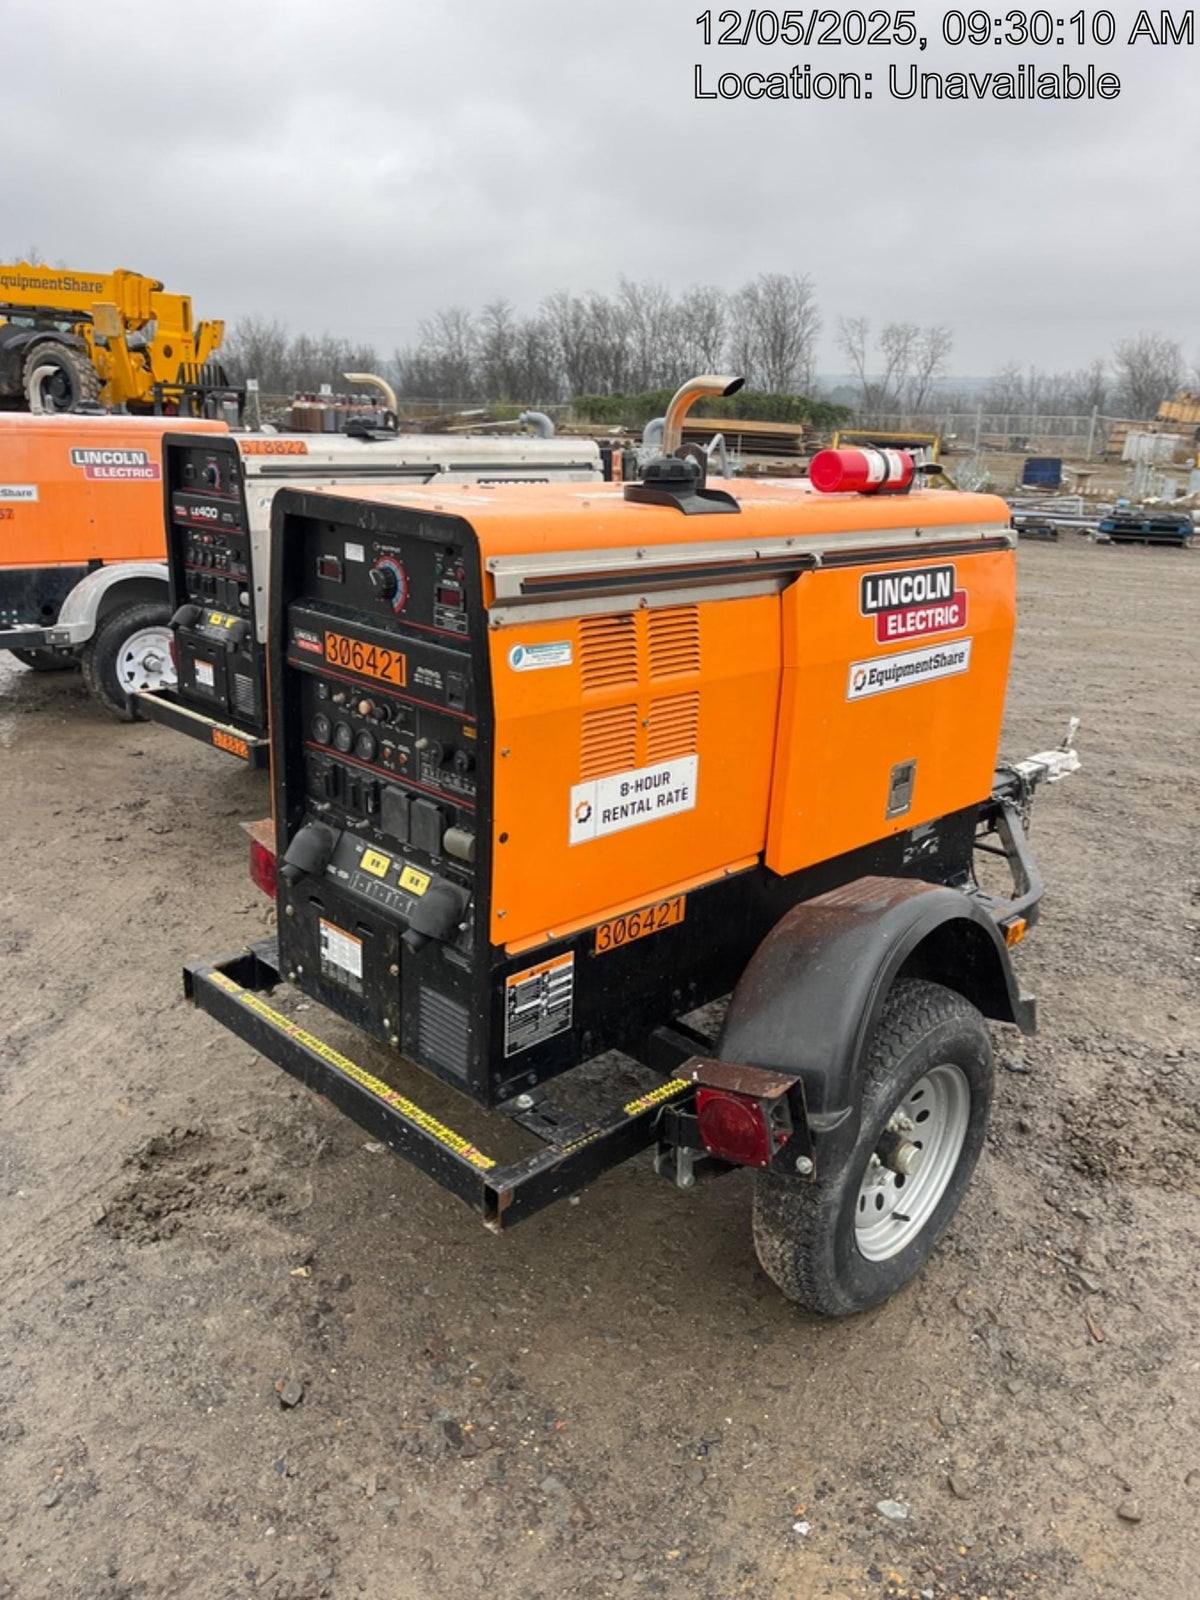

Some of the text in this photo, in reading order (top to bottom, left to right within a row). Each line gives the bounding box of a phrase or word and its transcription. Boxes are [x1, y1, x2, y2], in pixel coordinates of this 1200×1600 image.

[75, 451, 144, 465] LINCOLN
[93, 467, 154, 478] ELECTRIC
[866, 571, 951, 609] LINCOLN
[887, 605, 959, 636] ELECTRIC
[326, 633, 404, 683] 306421
[868, 651, 965, 687] EquipmentShare
[620, 771, 671, 797] 8-HOUR
[602, 787, 689, 823] RENTAL RATE
[598, 898, 682, 950] 306421
